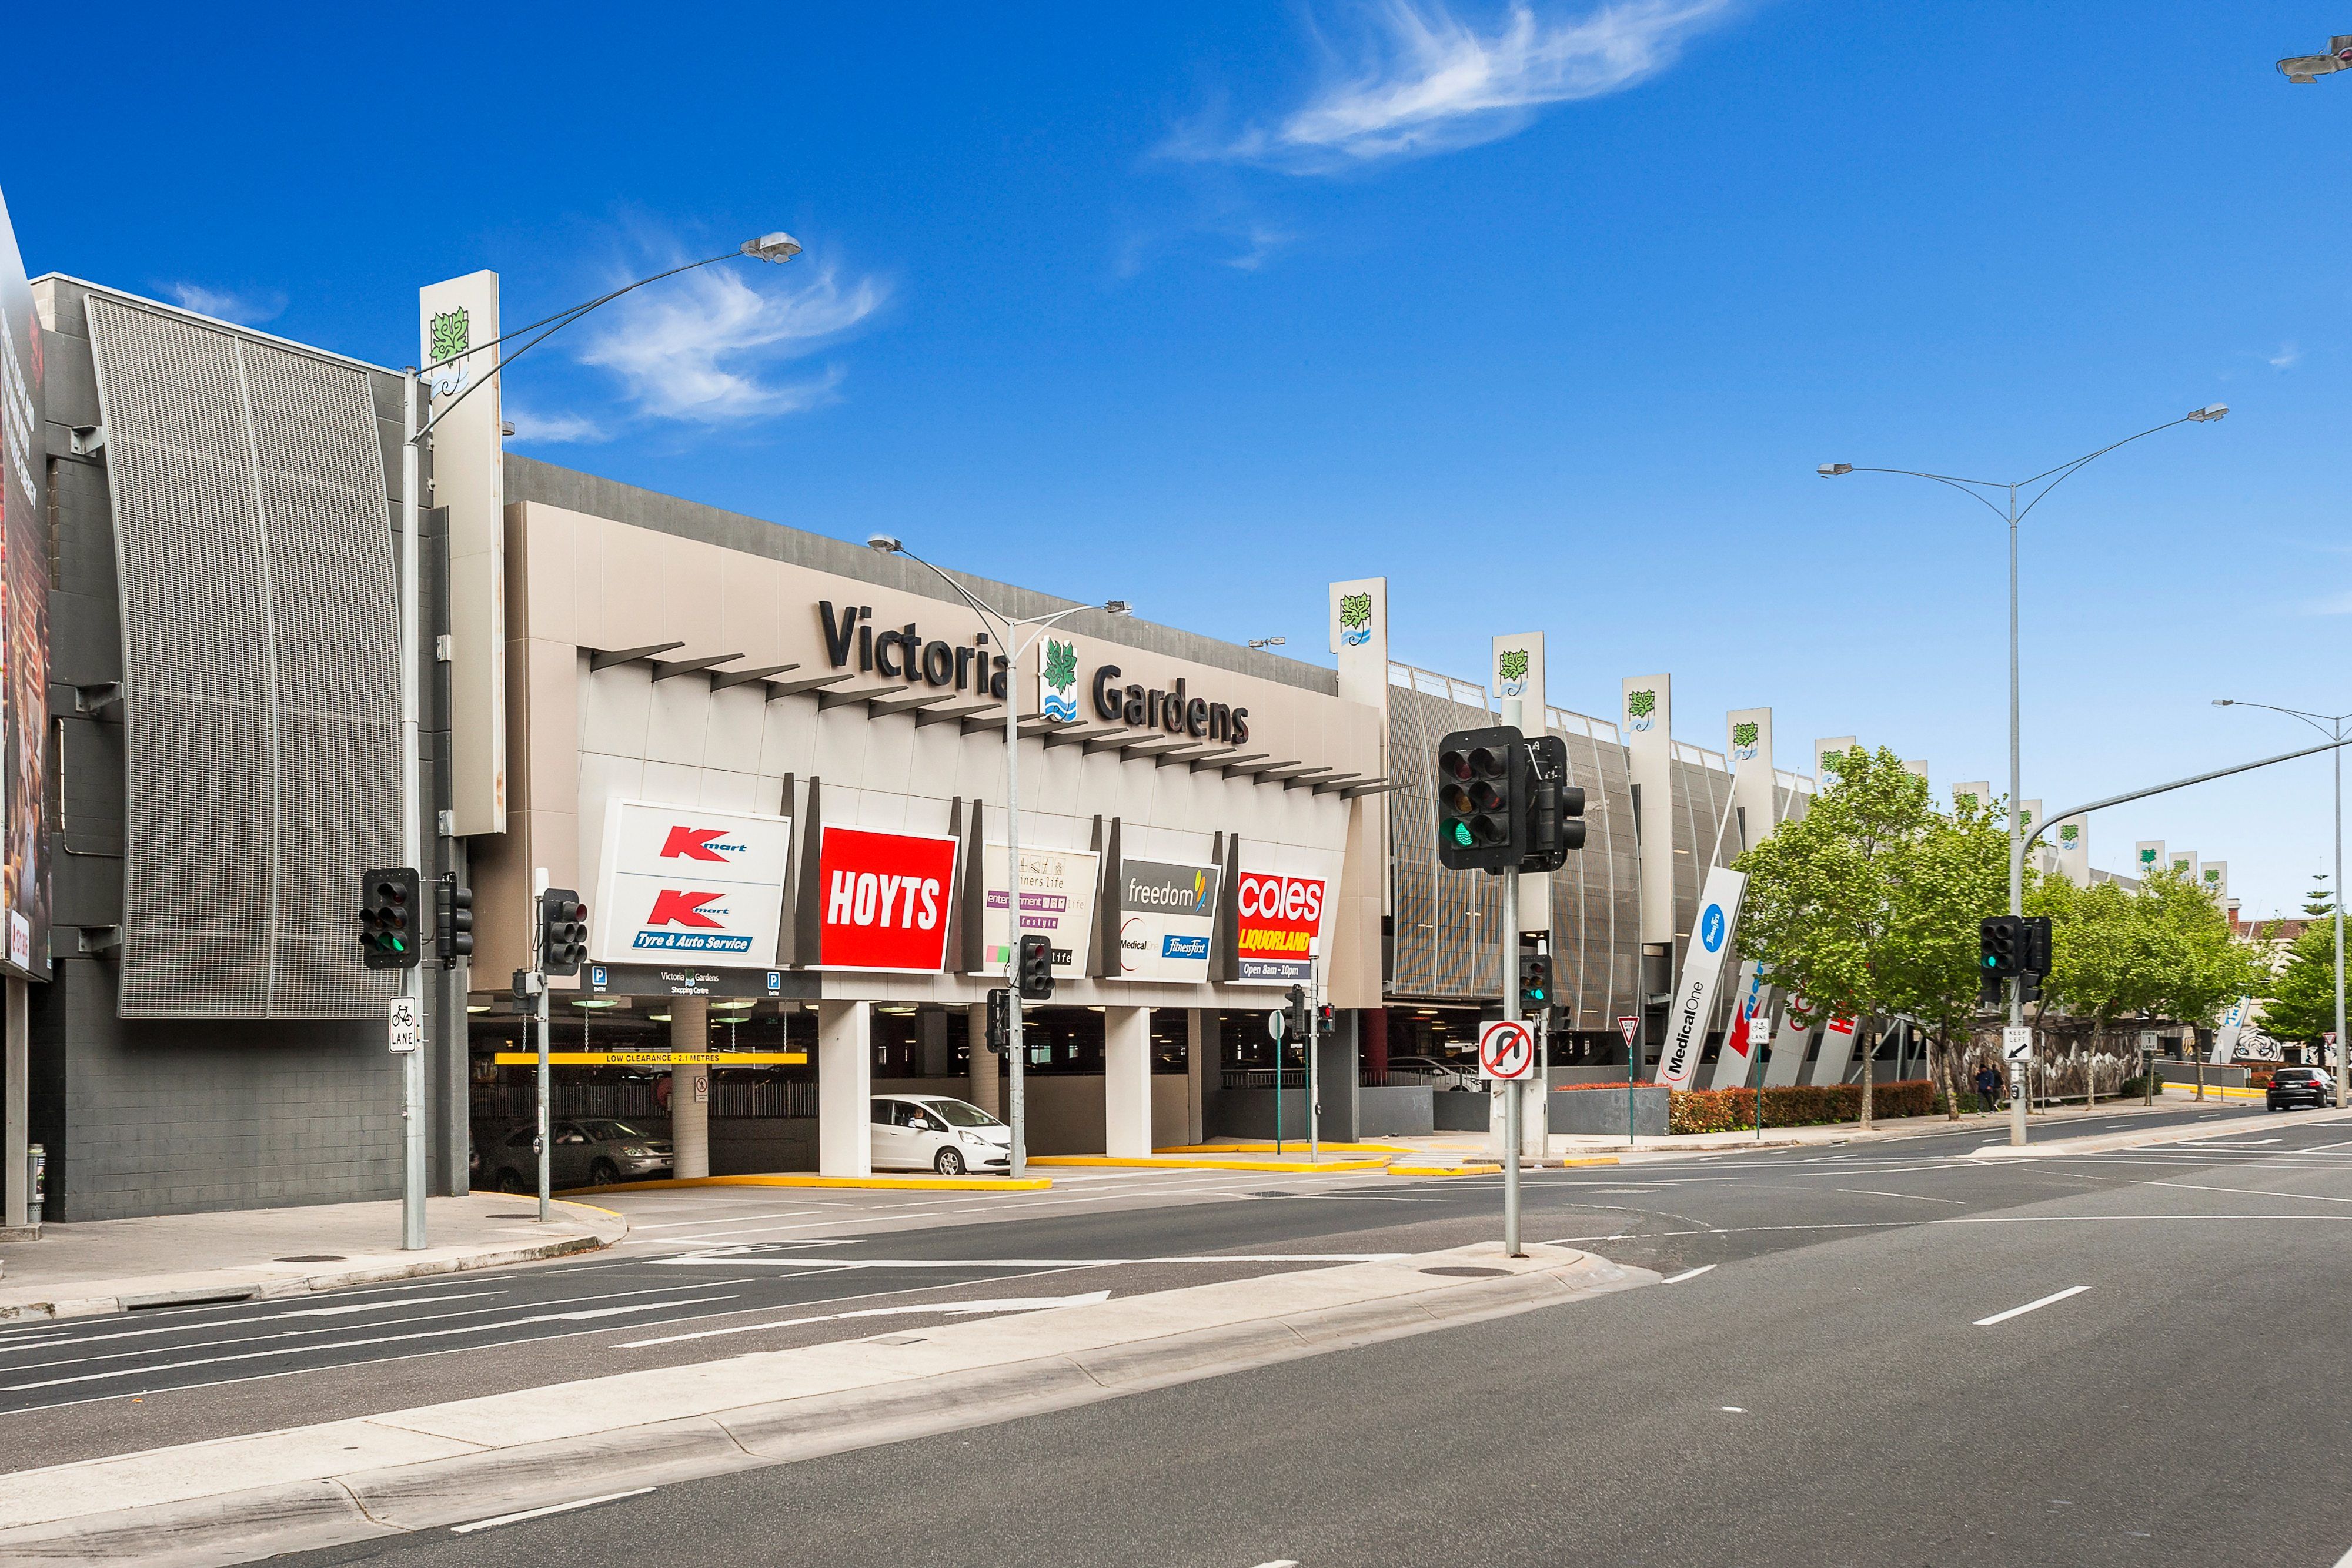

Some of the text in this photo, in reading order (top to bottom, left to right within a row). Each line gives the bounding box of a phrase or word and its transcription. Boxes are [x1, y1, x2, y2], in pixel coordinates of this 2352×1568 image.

[819, 600, 1249, 744] Victoria Gardens
[660, 825, 747, 863] Kmart
[1020, 874, 1064, 888] iners life
[1128, 877, 1194, 907] freedom
[1238, 877, 1322, 922] coles
[827, 870, 940, 930] HOYTS
[1068, 898, 1084, 910] life
[647, 889, 730, 929] Kmart
[1021, 917, 1057, 928] festyle
[637, 933, 749, 950] Tyre & Auto Service
[1238, 928, 1311, 952] LIQUORLAND
[1051, 952, 1071, 963] life
[661, 972, 719, 982] Victoria Gardens
[1244, 963, 1261, 977] Open
[671, 986, 693, 995] Shopping
[392, 1032, 413, 1045] LANE
